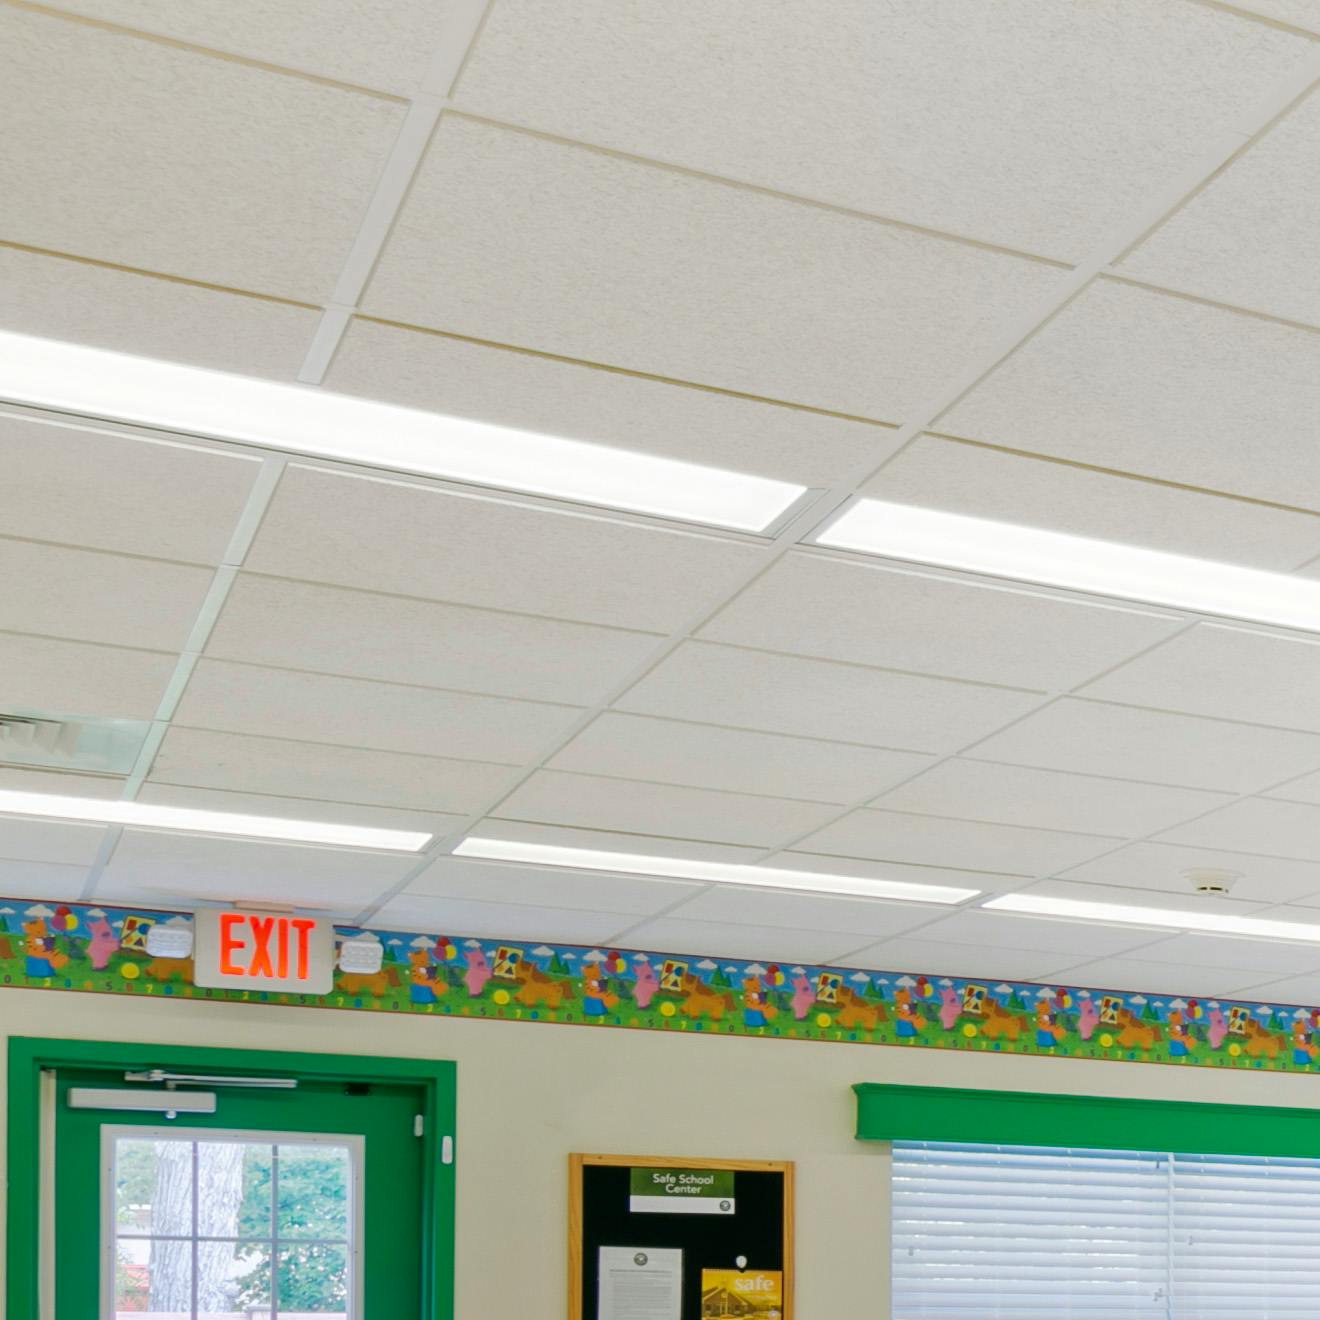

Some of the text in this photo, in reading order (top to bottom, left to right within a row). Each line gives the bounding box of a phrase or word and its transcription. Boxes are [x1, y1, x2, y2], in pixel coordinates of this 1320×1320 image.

[218, 913, 316, 979] EXIT
[652, 1173, 714, 1185] Safe School
[665, 1184, 702, 1194] Center
[734, 1274, 774, 1291] safe
